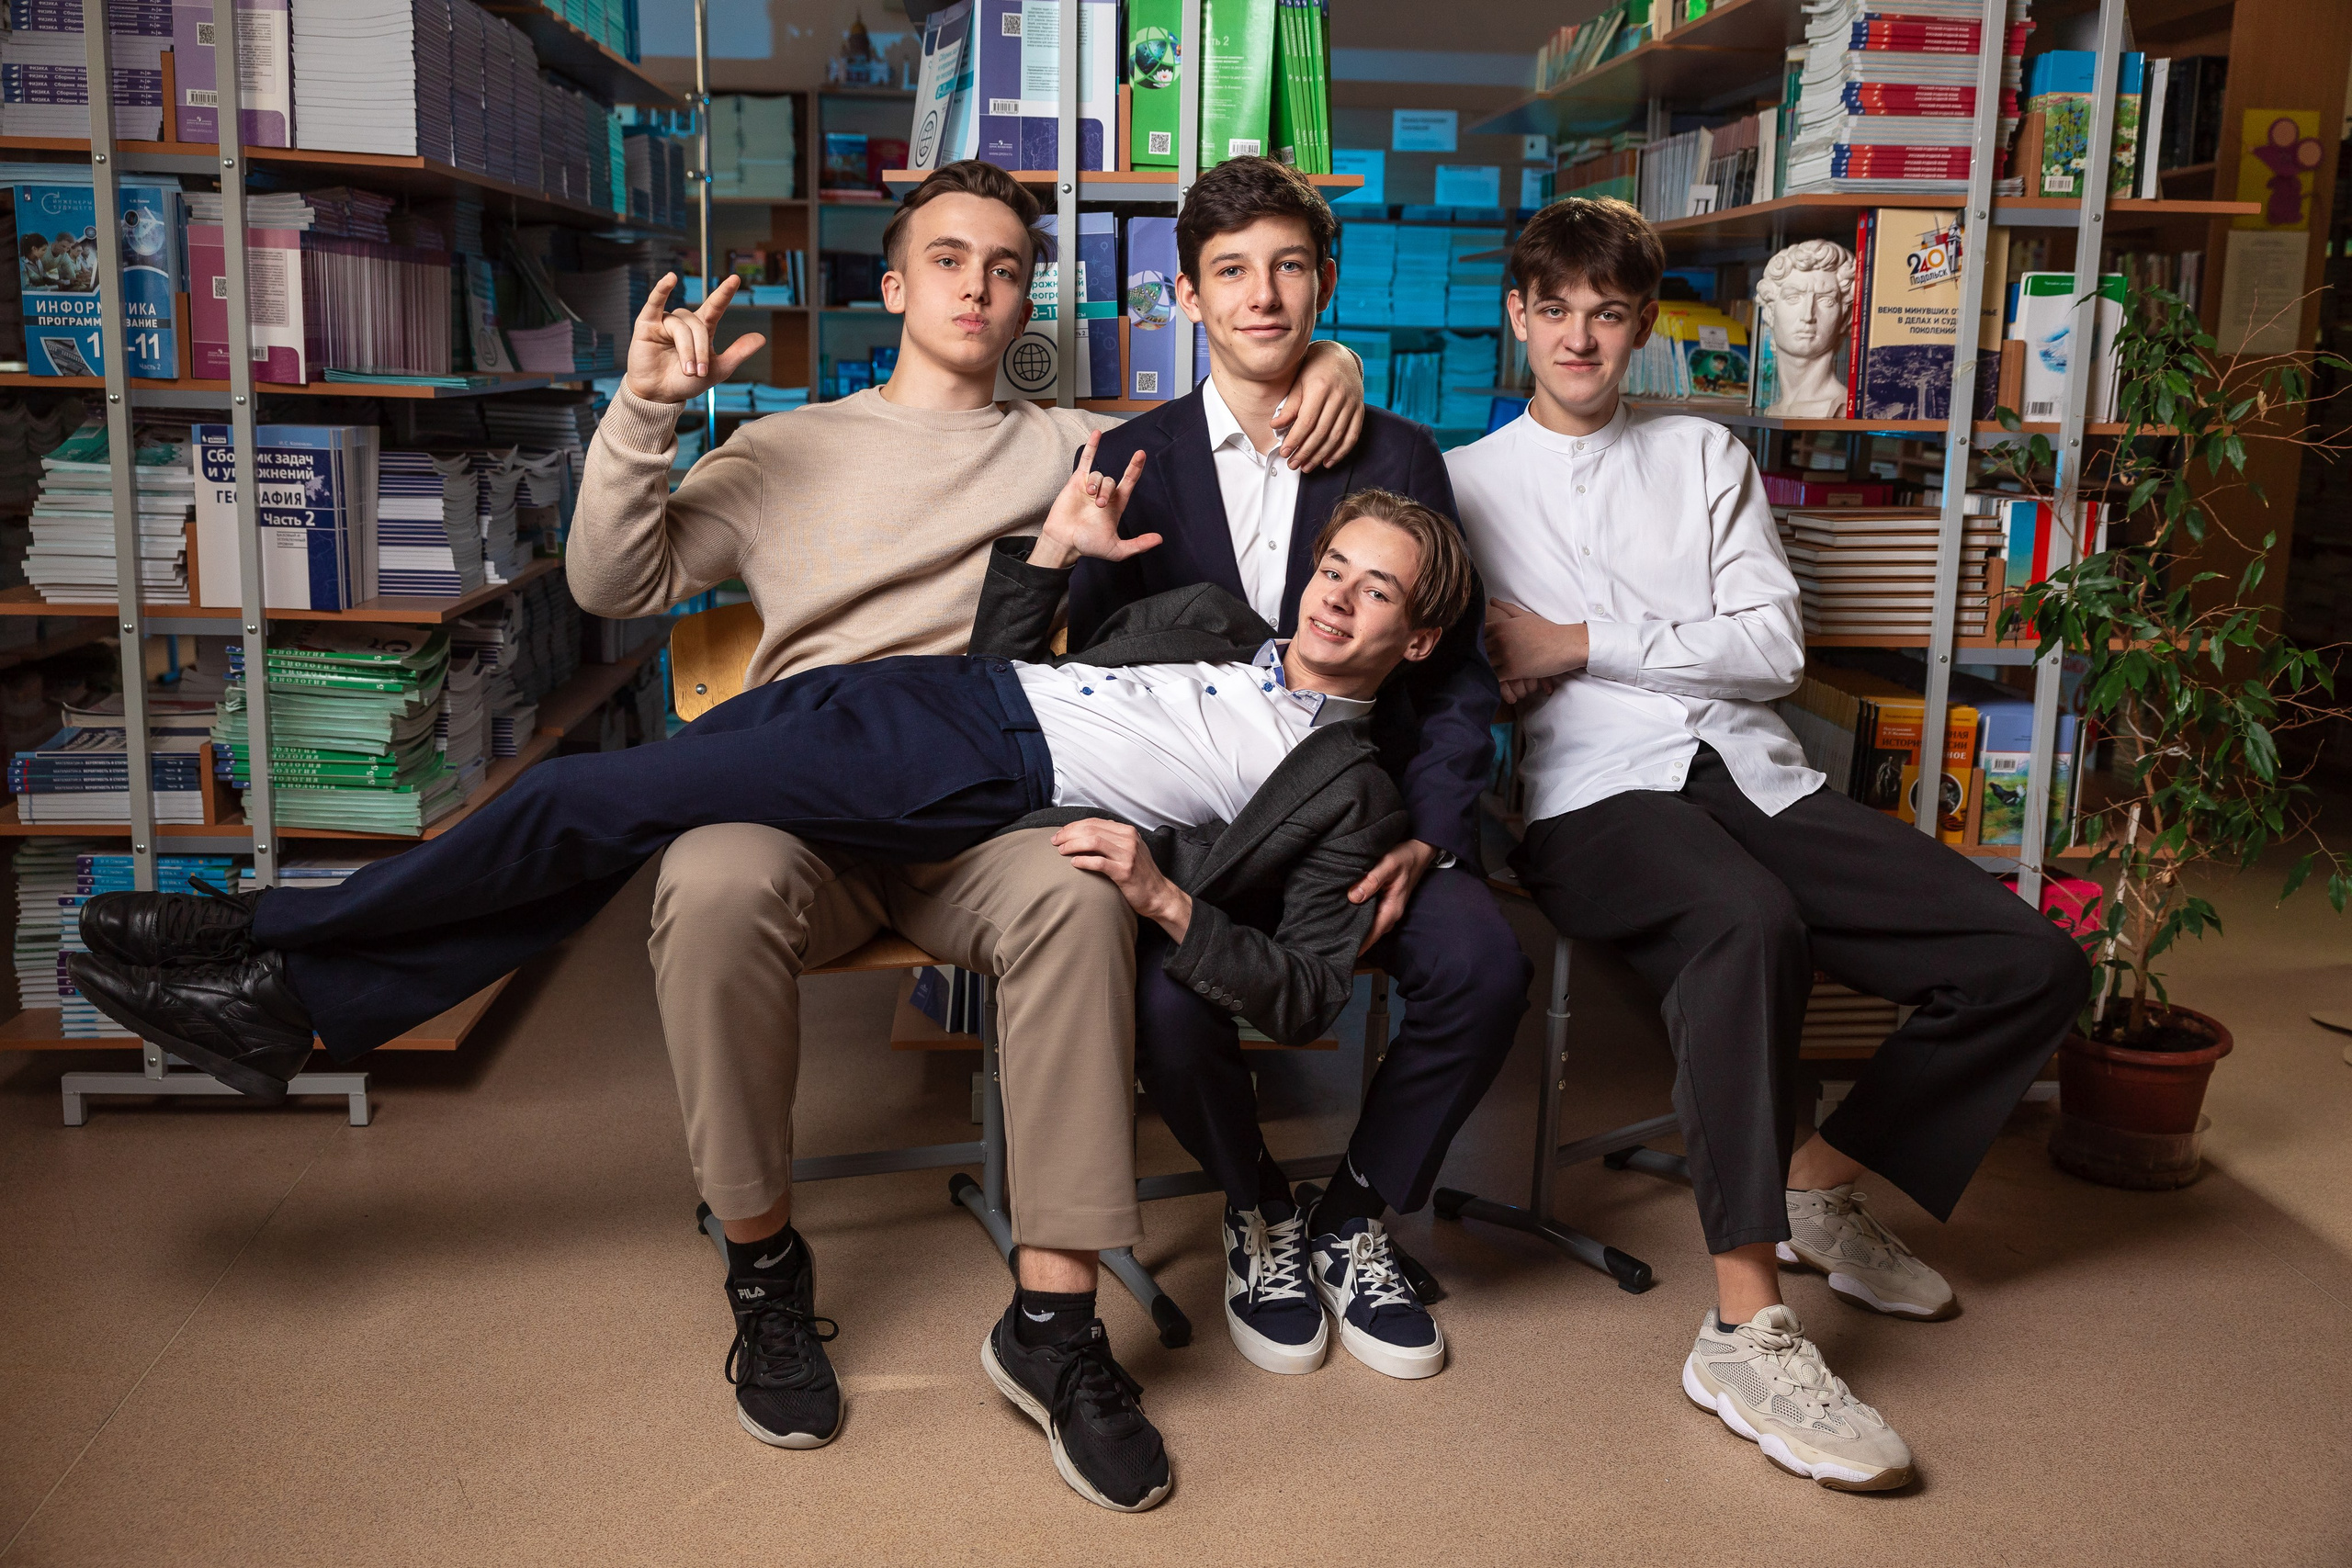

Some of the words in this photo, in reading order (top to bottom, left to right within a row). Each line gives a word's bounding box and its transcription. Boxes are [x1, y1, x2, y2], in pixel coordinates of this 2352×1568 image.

[1223, 36, 1229, 46] 2
[1907, 248, 1945, 276] 240
[1910, 268, 1948, 286] Подольск
[1878, 306, 1903, 314] ВЕКОВ
[1905, 307, 1950, 315] МИНУВШИХ
[1905, 317, 1931, 325] ДЕЛАХ
[1910, 326, 1956, 334] ПОКОЛЕНИЙ
[1848, 400, 1853, 411] 2
[1857, 400, 1860, 411] 1
[275, 455, 313, 467] задач
[208, 467, 218, 477] и
[264, 513, 301, 525] Часть
[305, 511, 315, 526] 2
[280, 660, 336, 670] БИОЛОГИЯ
[272, 676, 326, 685] БИОЛОГИЯ
[1882, 739, 1922, 747] ИСТОРИ
[738, 1286, 765, 1299] FILA
